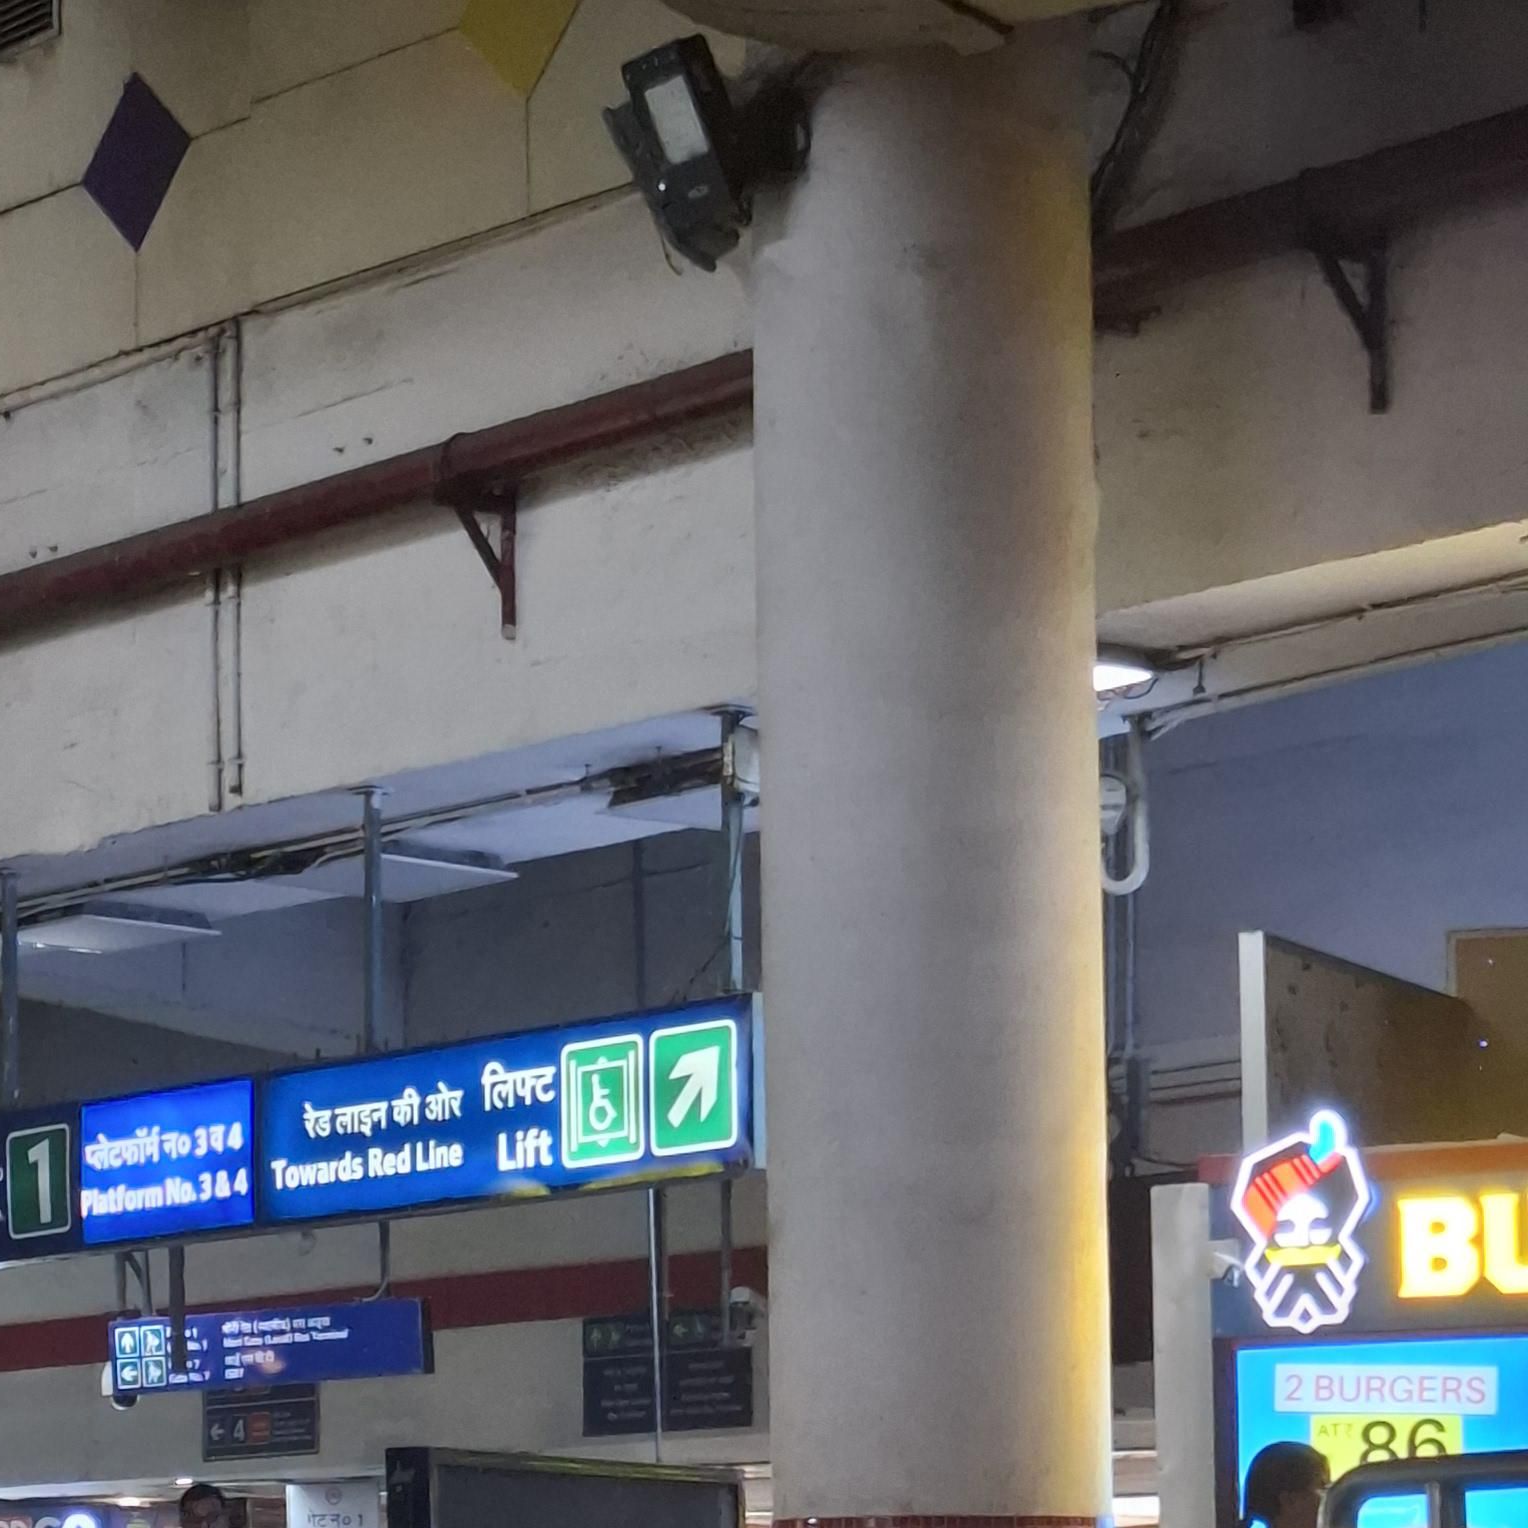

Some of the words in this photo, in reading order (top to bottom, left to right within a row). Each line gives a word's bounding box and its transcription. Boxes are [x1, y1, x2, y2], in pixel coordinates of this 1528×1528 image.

[303, 1101, 332, 1139] रेड
[334, 1101, 388, 1138] लाइन
[391, 1087, 420, 1127] की
[425, 1081, 464, 1121] ओर
[481, 1061, 557, 1111] लिफ्ट
[194, 1127, 208, 1156] 3
[209, 1123, 225, 1154] व
[227, 1121, 244, 1151] 4
[497, 1127, 553, 1172] Lift
[27, 1137, 52, 1225] 1
[271, 1150, 364, 1190] Towards
[368, 1142, 411, 1177] Red
[416, 1139, 464, 1172] Line
[80, 1184, 163, 1219] Platform
[164, 1176, 197, 1207] No.
[198, 1172, 212, 1203] 3
[214, 1169, 231, 1199] &
[232, 1167, 248, 1196] 4
[1284, 1374, 1303, 1401] 2
[1314, 1374, 1487, 1405] BURGERS
[233, 1416, 245, 1442] 4
[1359, 1418, 1448, 1464] 86
